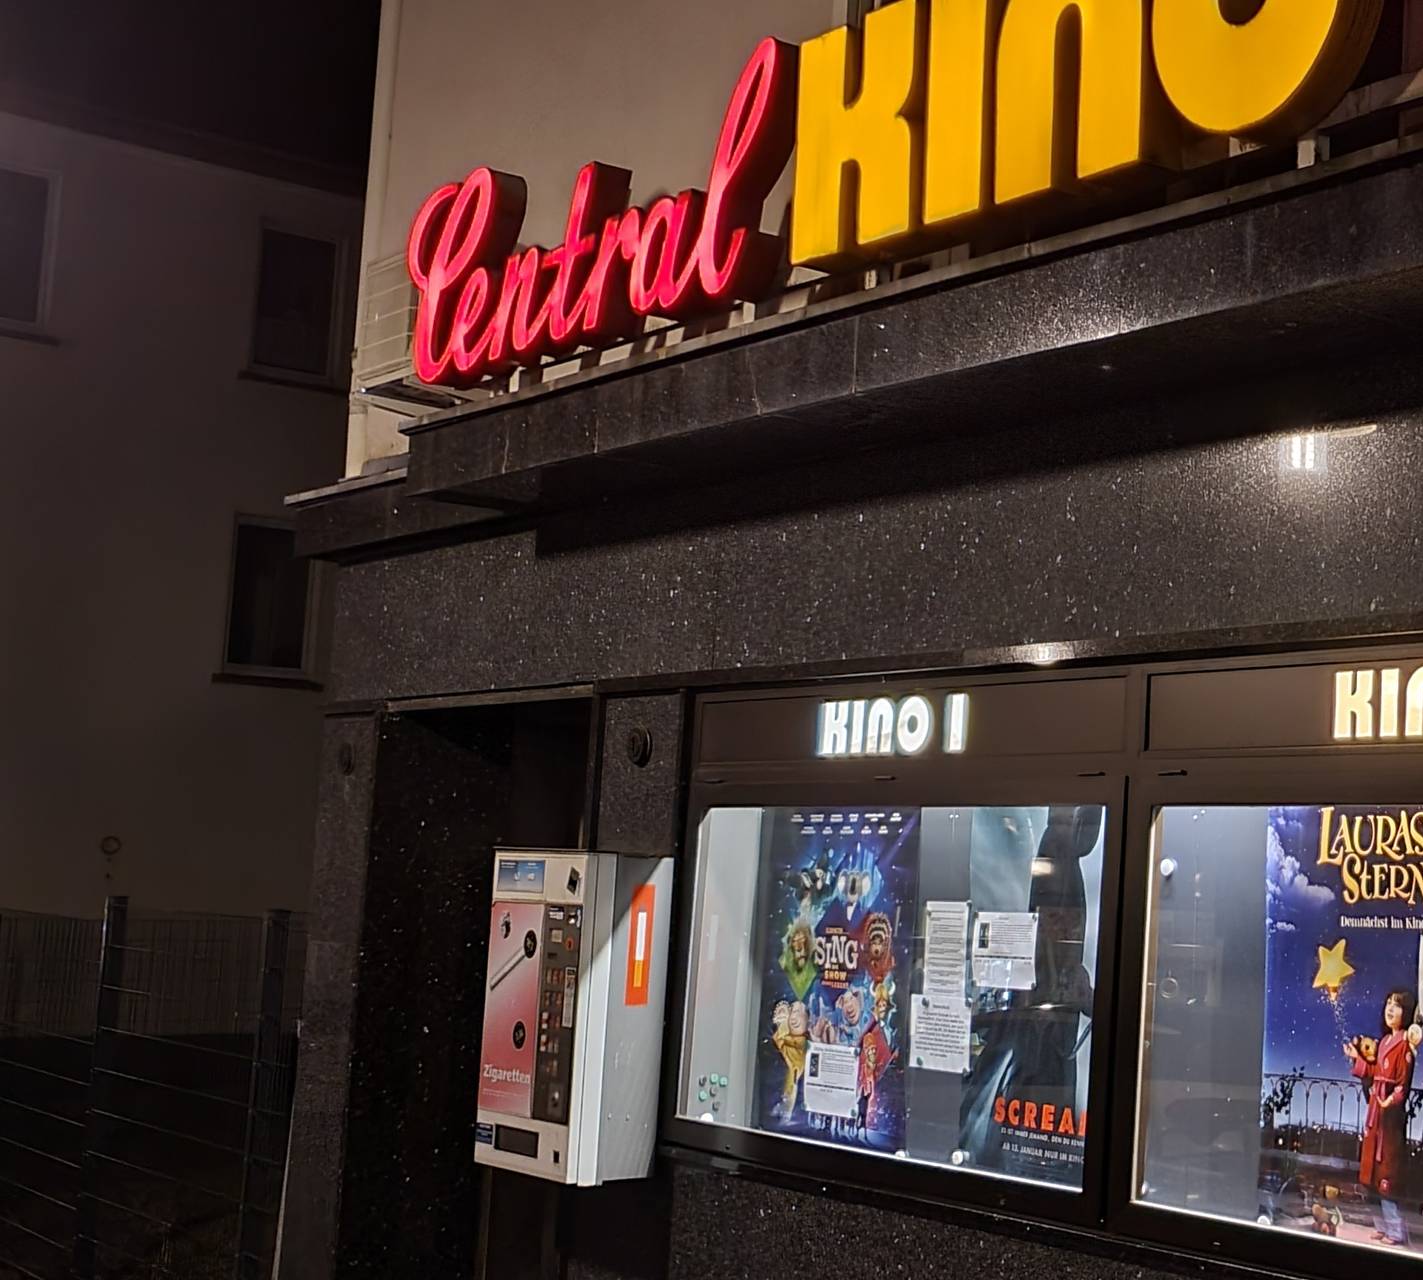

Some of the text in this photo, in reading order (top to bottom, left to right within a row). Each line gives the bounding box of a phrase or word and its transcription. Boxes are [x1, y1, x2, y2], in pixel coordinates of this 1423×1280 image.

[407, 36, 777, 383] Central
[818, 696, 933, 755] KINO
[814, 935, 859, 970] SING
[483, 1063, 531, 1084] Zigaretten
[1020, 1145, 1043, 1157] JANUAR
